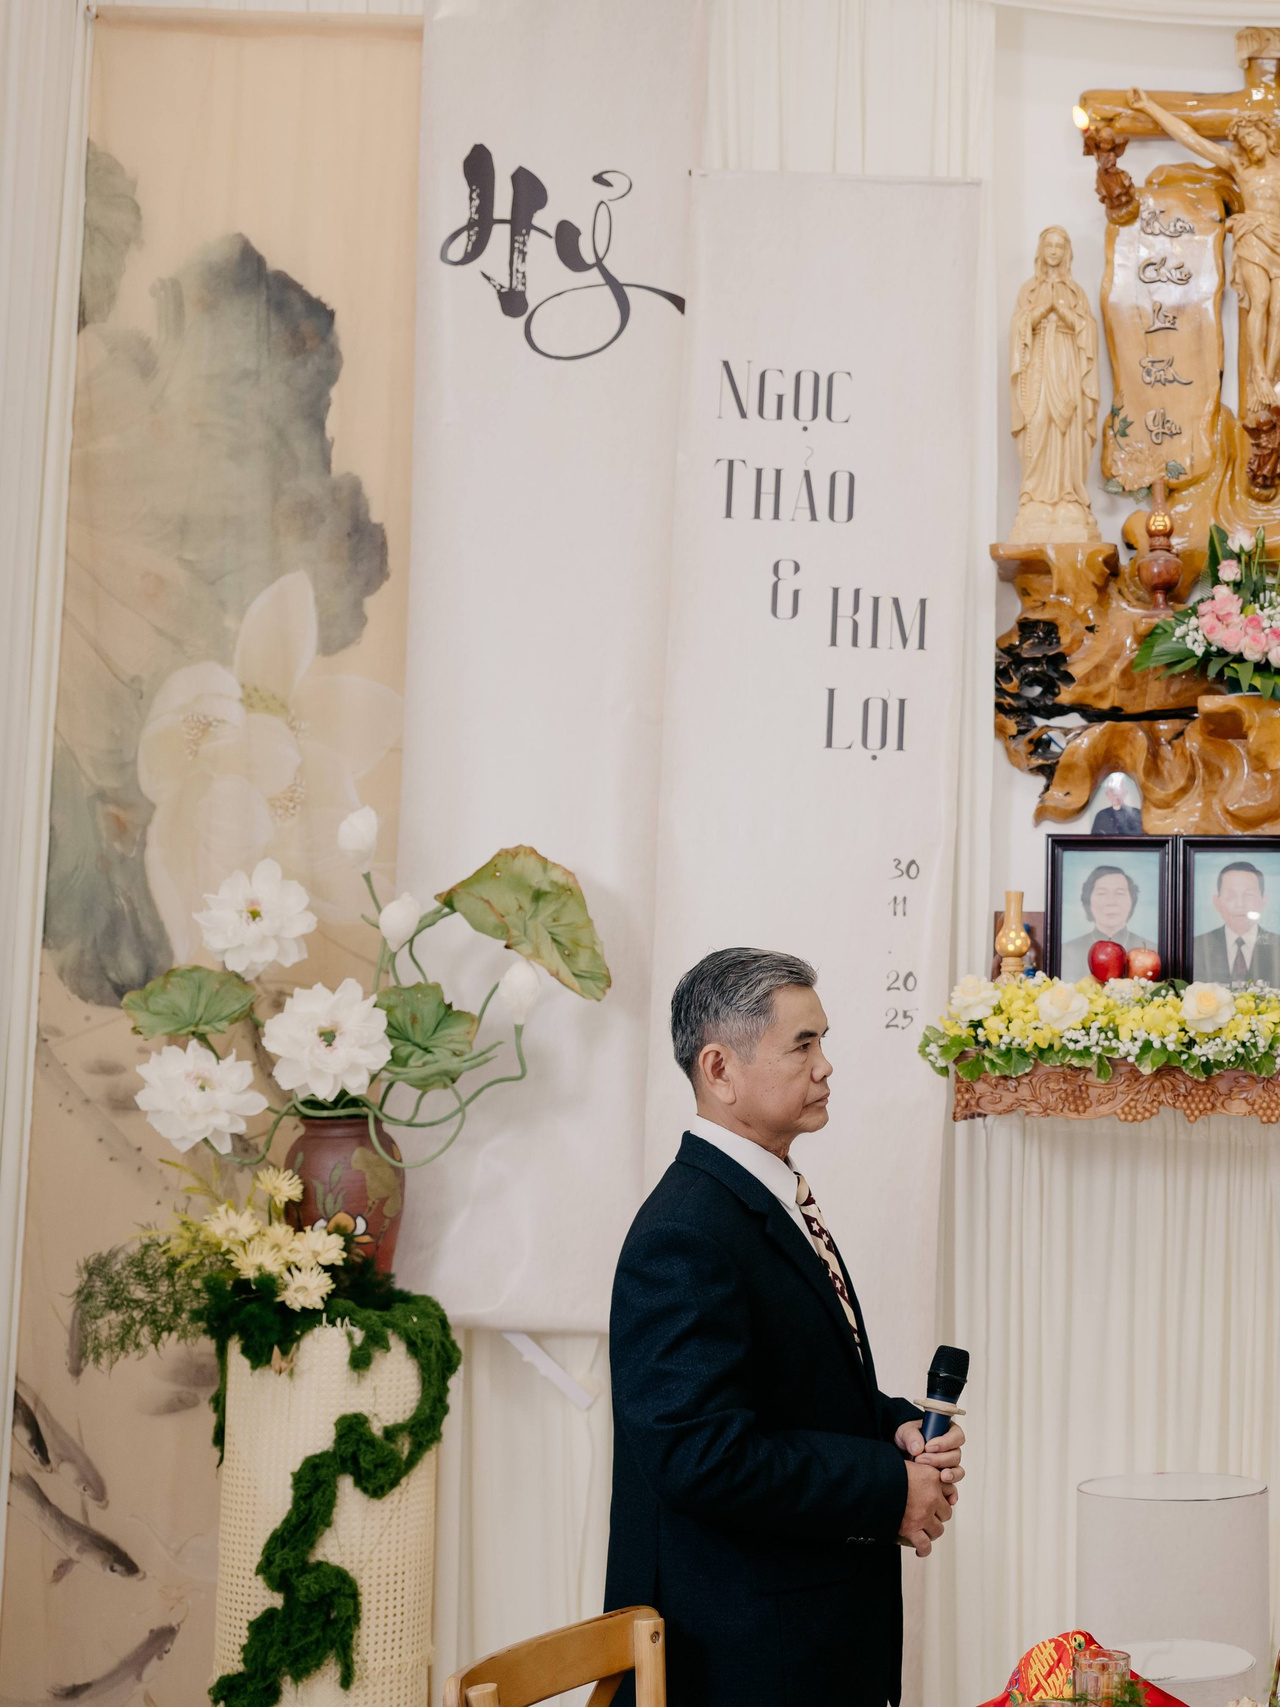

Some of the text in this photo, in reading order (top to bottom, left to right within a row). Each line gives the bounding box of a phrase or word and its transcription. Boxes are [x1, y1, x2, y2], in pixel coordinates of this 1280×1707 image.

[769, 558, 803, 621] &
[887, 857, 921, 880] 30
[887, 895, 908, 918] 11
[885, 969, 918, 992] 20
[884, 1007, 920, 1031] 25
